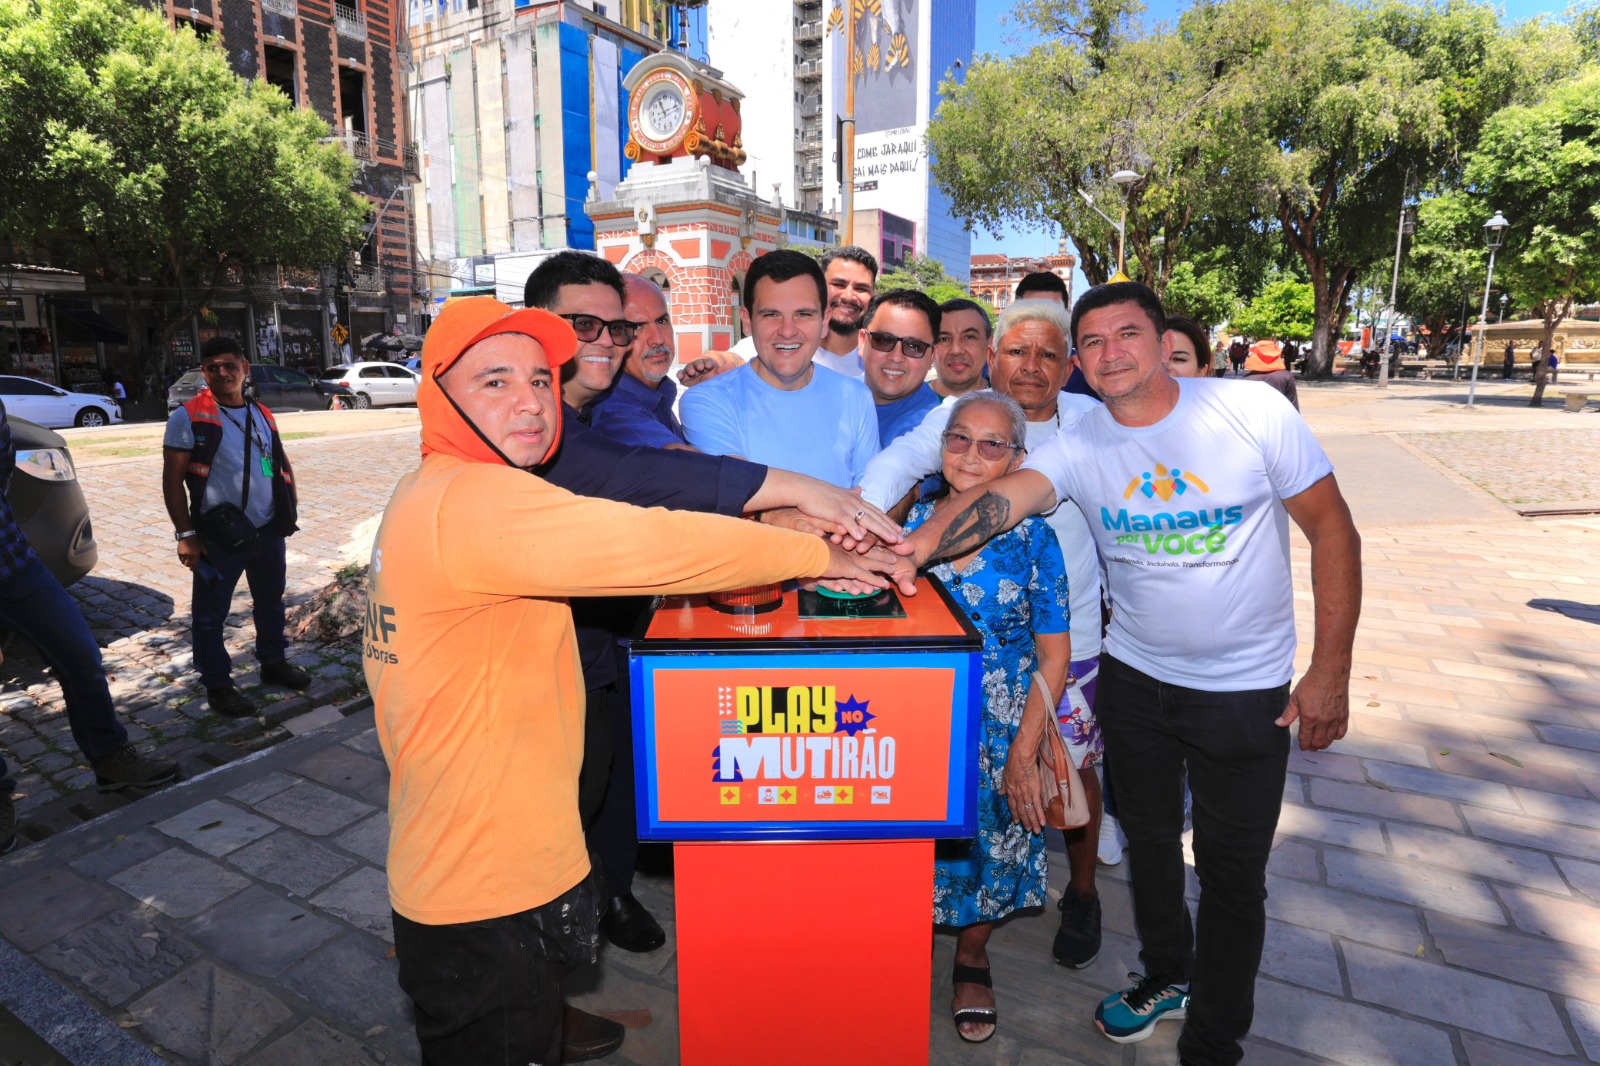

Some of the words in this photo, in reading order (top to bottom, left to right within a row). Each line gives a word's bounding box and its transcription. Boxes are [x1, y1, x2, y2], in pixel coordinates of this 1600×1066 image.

[857, 146, 878, 160] COME
[881, 139, 917, 156] JARAQUI
[868, 163, 888, 176] MAIS
[1101, 505, 1243, 532] Manaus
[1116, 533, 1140, 545] por
[736, 685, 836, 734] PLAY
[841, 710, 864, 724] NO
[719, 727, 896, 780] MUTIRÃO
